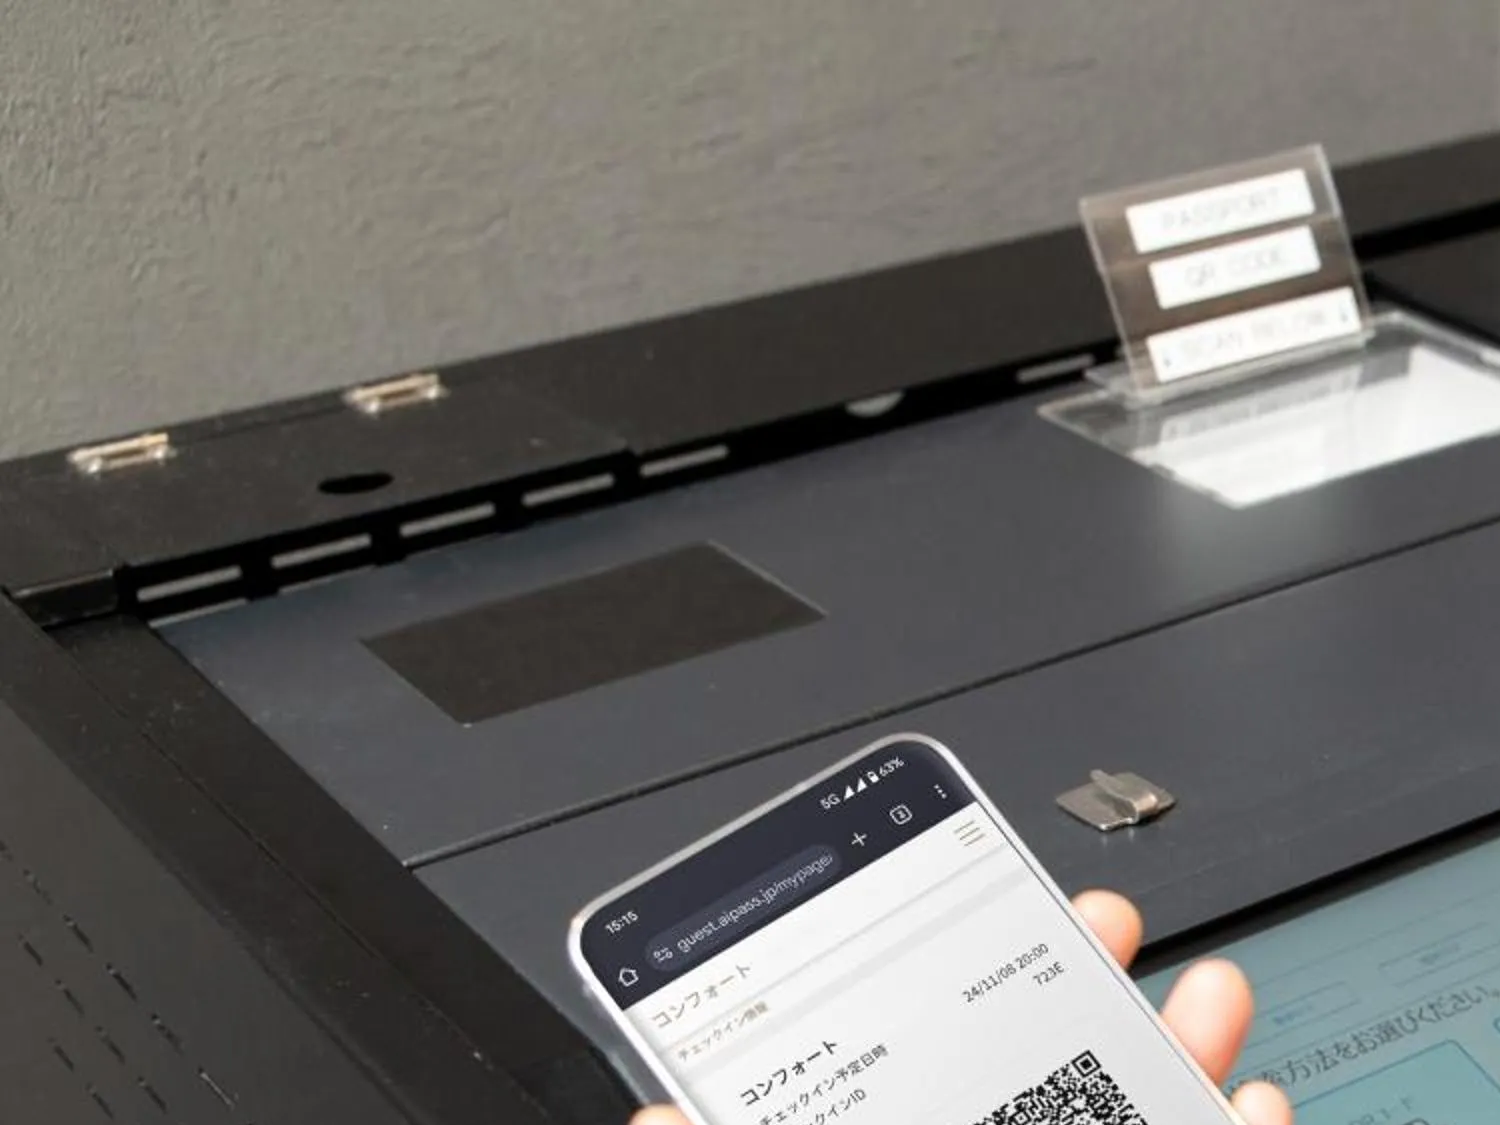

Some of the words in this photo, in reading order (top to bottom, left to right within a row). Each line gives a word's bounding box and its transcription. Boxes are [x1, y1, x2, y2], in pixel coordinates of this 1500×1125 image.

[879, 756, 905, 777] 63%
[605, 911, 639, 934] 15:15
[652, 964, 750, 1028] コンフォート
[962, 963, 1017, 1003] 24/11/08
[1015, 943, 1049, 969] 20:00
[740, 1041, 838, 1106] コンフォート
